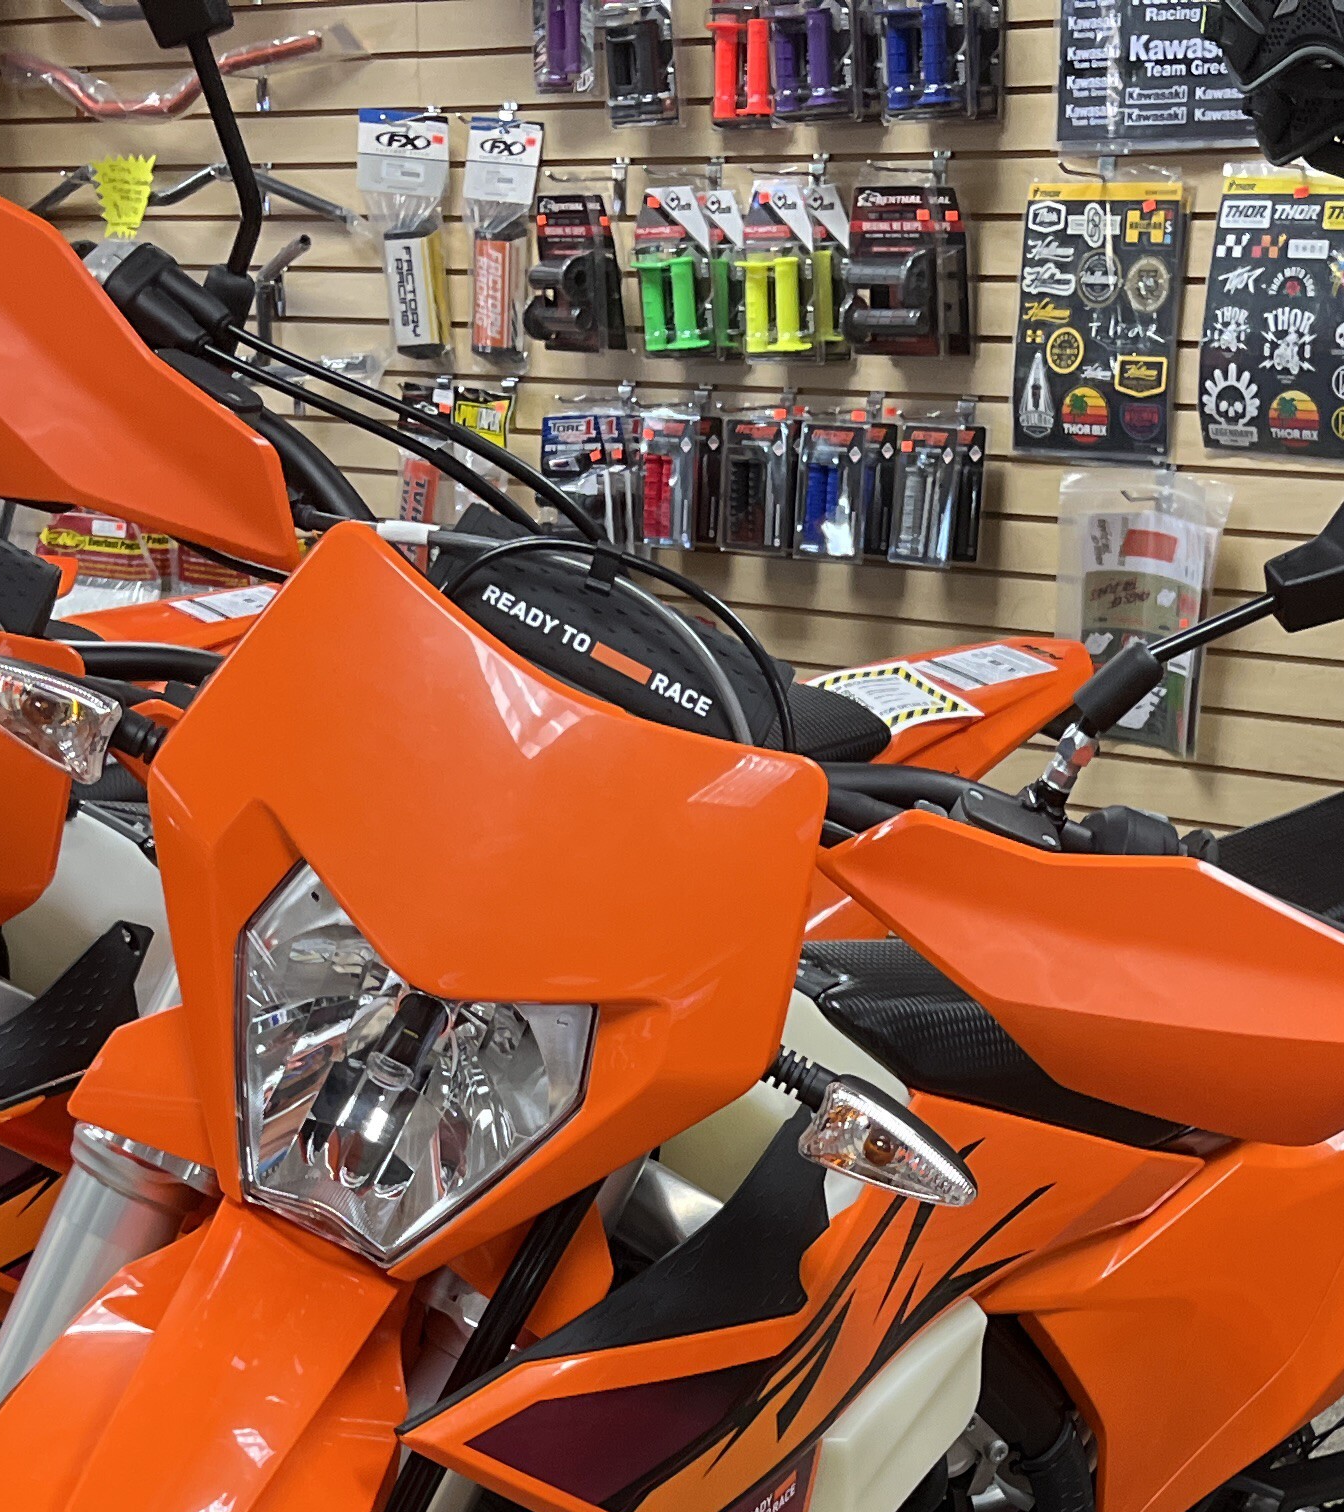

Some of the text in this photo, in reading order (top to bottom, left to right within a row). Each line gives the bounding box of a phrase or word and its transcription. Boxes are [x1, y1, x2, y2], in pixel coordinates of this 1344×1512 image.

[1145, 6, 1201, 22] Racing
[1129, 34, 1223, 62] Kawas
[1145, 60, 1229, 77] Team Gree
[1225, 205, 1268, 219] THOR
[1274, 204, 1322, 220] THOR
[395, 258, 410, 328] RACING
[403, 246, 421, 337] FACTORY
[1215, 306, 1249, 323] THOR
[1264, 307, 1316, 334] THOR
[481, 584, 713, 718] READY TO RACE
